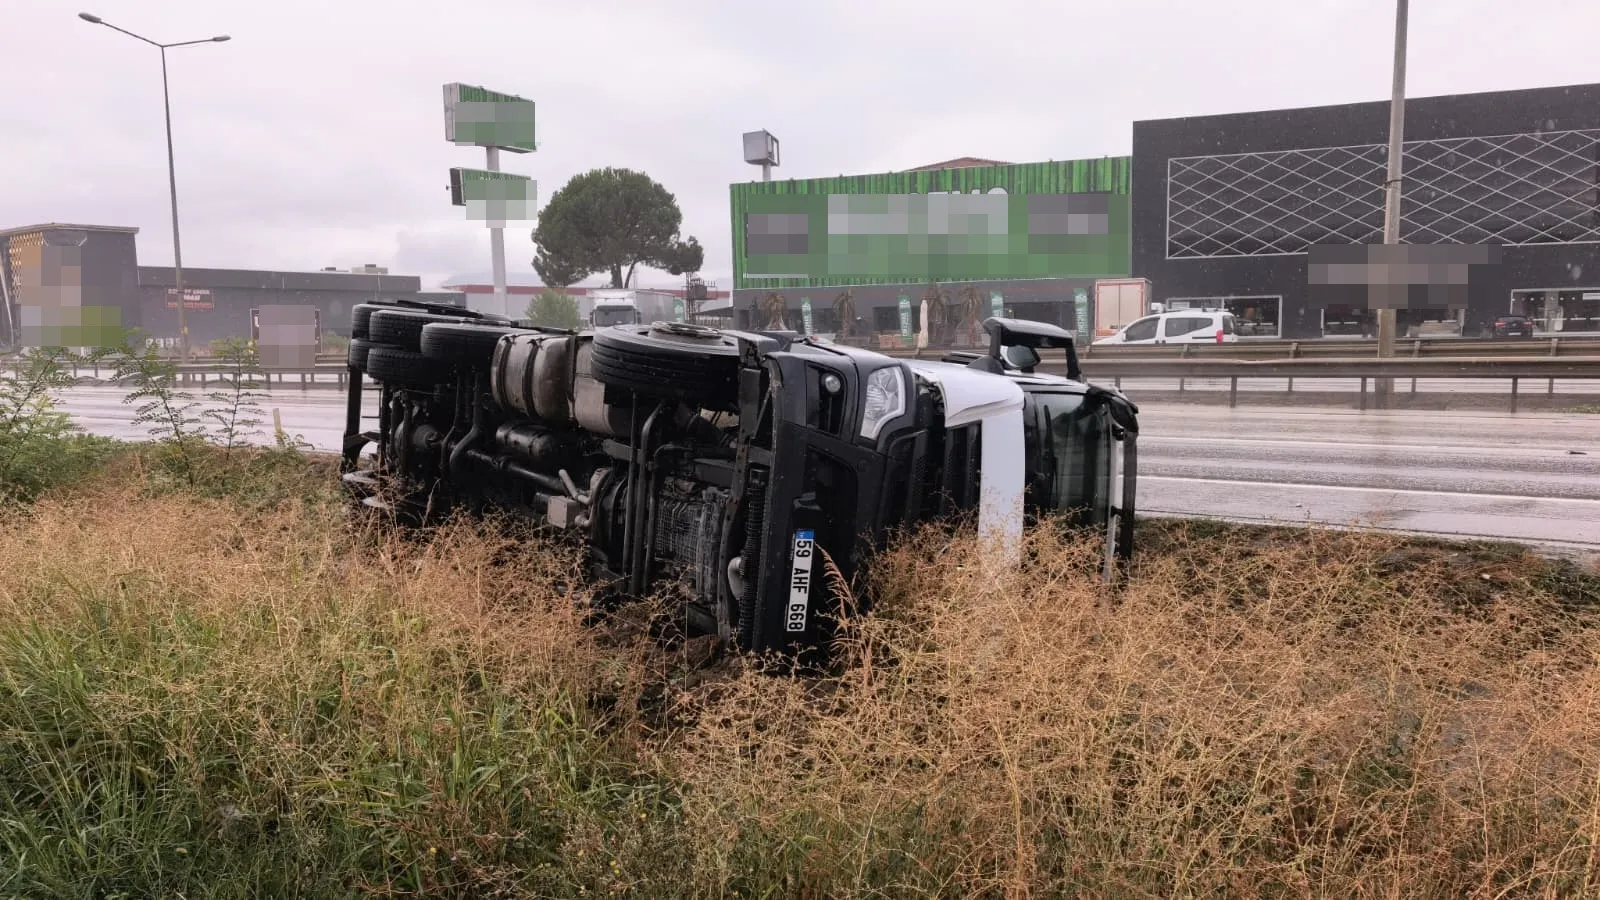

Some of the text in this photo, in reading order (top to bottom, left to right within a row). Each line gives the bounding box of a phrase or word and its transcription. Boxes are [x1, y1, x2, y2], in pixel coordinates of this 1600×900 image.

[789, 540, 811, 630] 59 AHF 668
